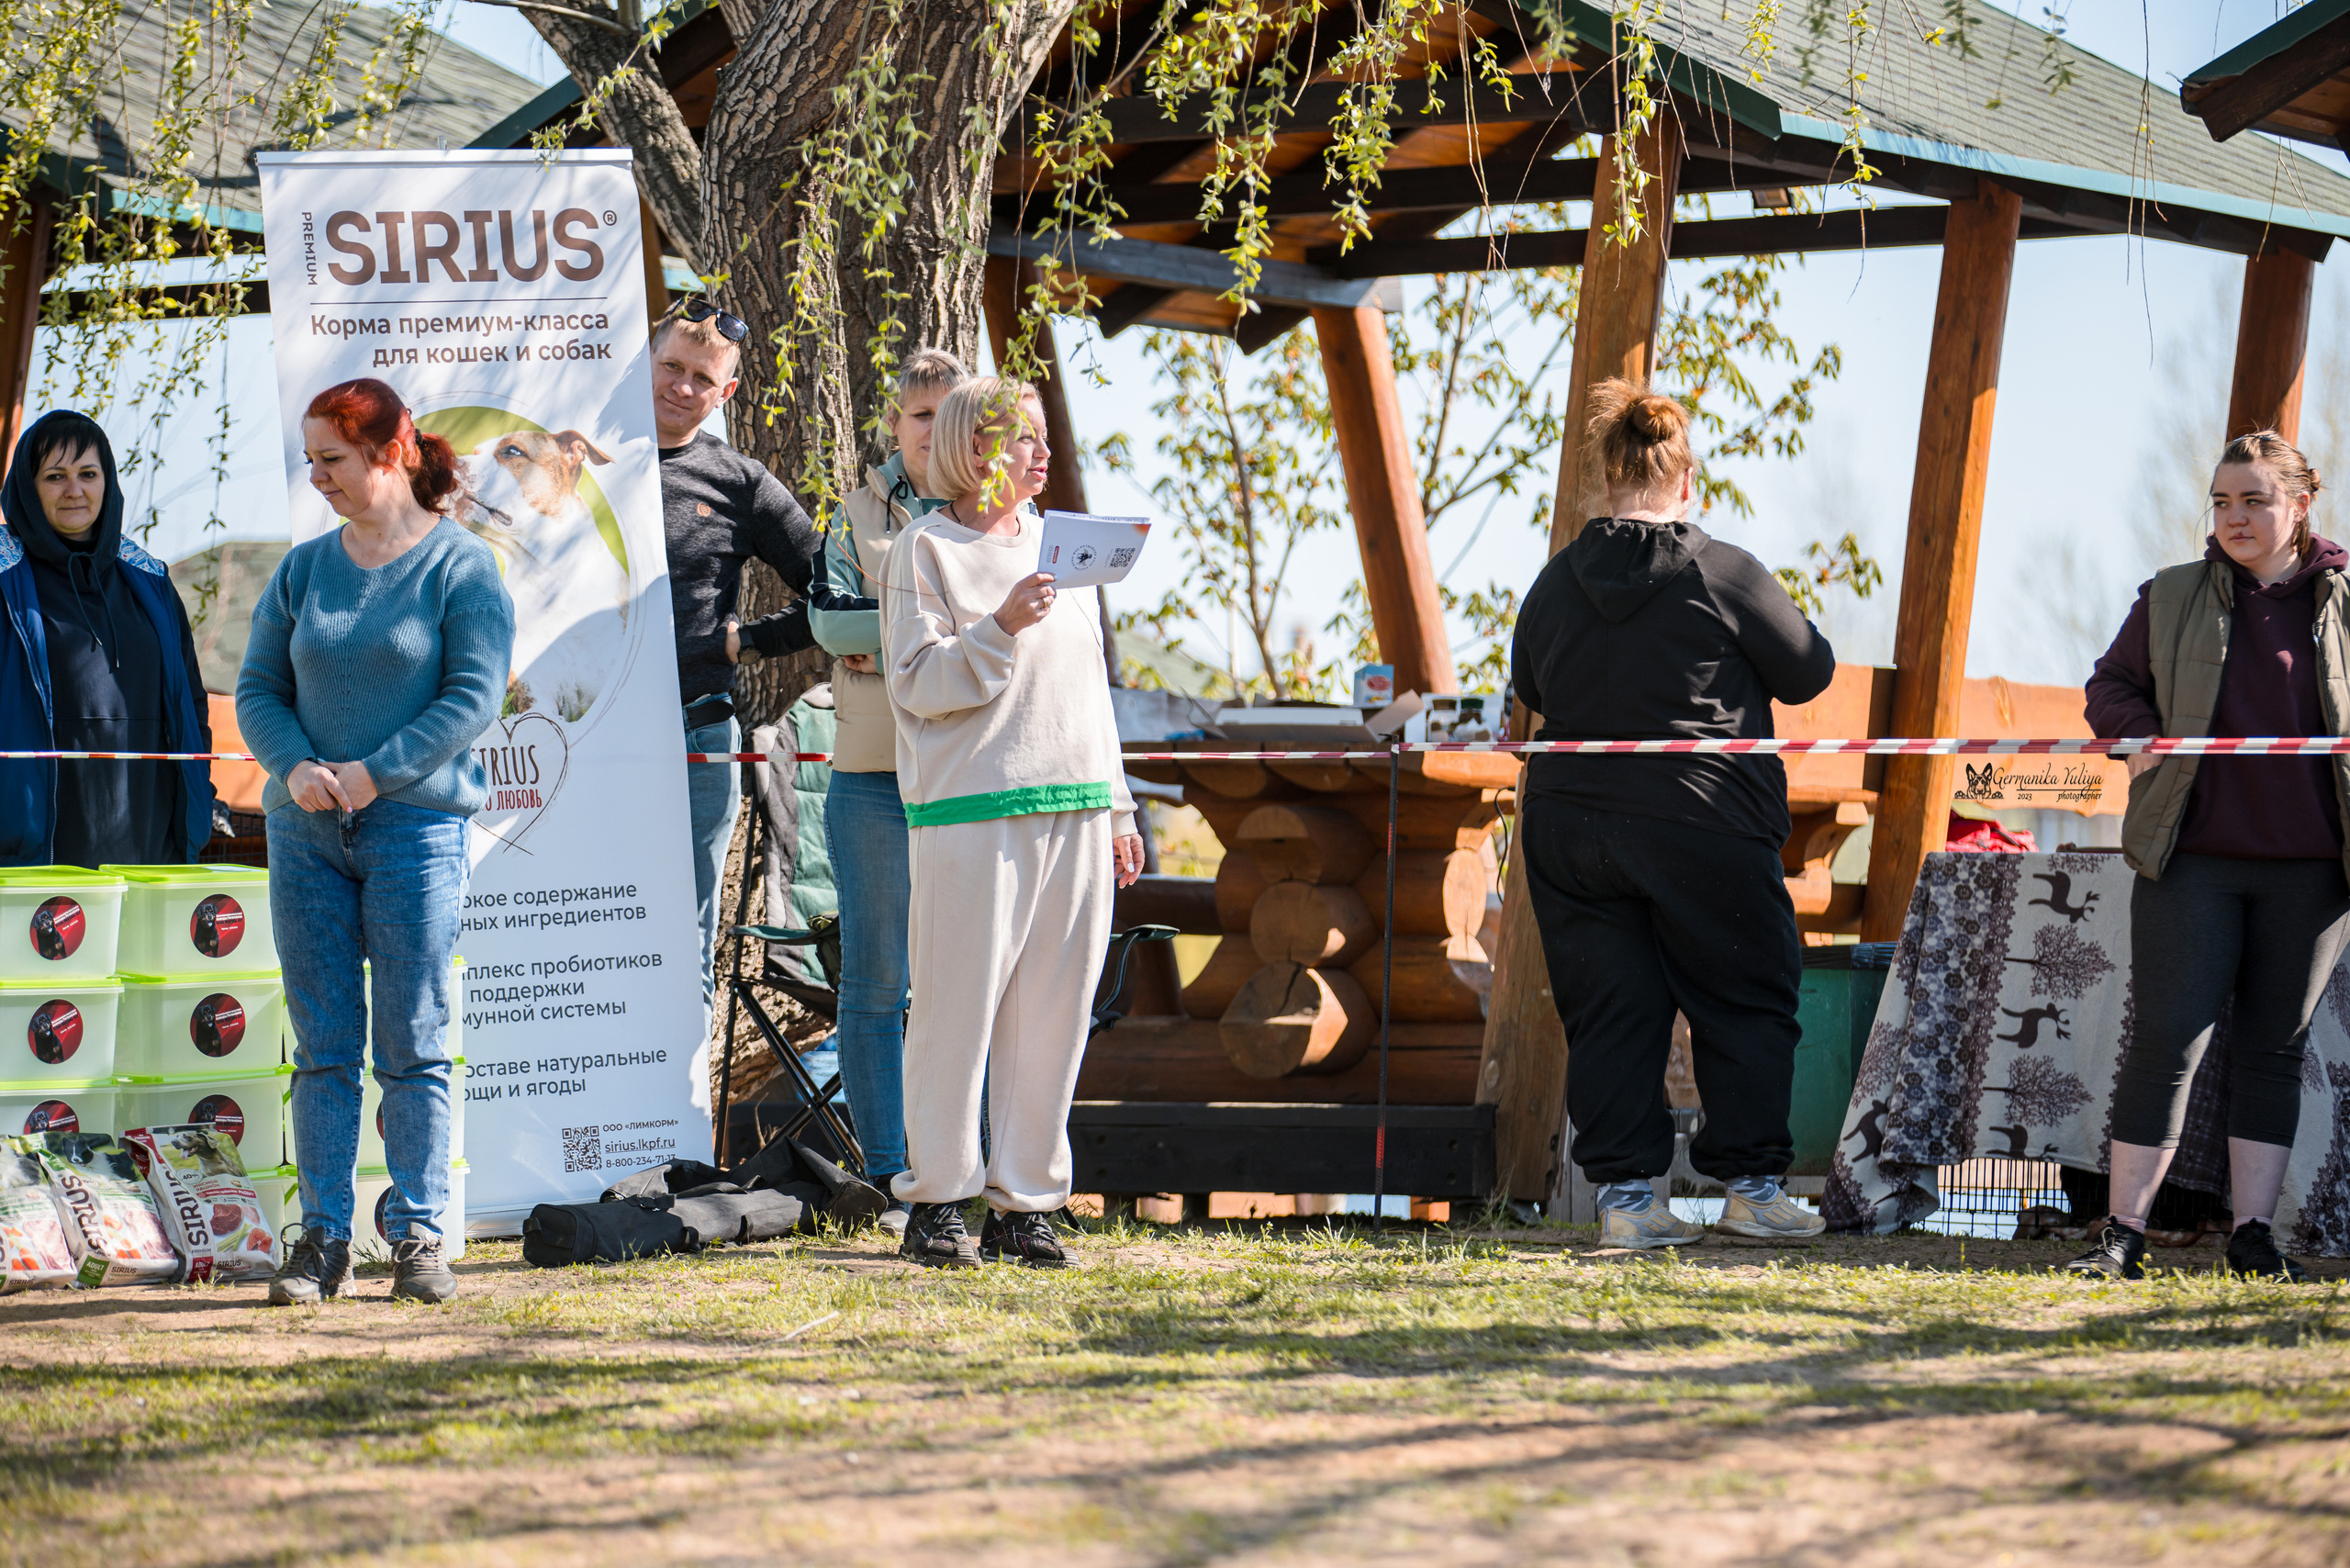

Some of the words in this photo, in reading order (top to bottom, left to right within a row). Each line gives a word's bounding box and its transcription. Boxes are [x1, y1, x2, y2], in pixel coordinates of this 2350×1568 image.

[301, 211, 319, 286] PREMIUM
[310, 314, 391, 340] Корма
[398, 311, 610, 339] премиум-класса
[373, 348, 420, 367] для
[426, 343, 509, 364] кошек
[516, 345, 532, 362] и
[537, 338, 613, 361] собак
[471, 744, 540, 787] IRIUS
[497, 788, 543, 811] ЛЮБОВЬ
[513, 884, 638, 906] содержание
[504, 905, 647, 931] ингредиентов
[531, 953, 663, 979] пробиотиков
[470, 980, 585, 1003] поддержки
[541, 1001, 627, 1020] системы
[537, 1049, 668, 1074] натуральные
[509, 1083, 521, 1098] и
[526, 1078, 588, 1096] ягоды
[602, 1123, 623, 1132] ООО
[624, 1118, 679, 1130] «ЛИМКОРМ»
[605, 1137, 676, 1152] sirius.lkpf.ru
[62, 1175, 108, 1250] SIRIUS
[85, 1260, 105, 1271] ADULT
[216, 1260, 242, 1268] SIRIUS
